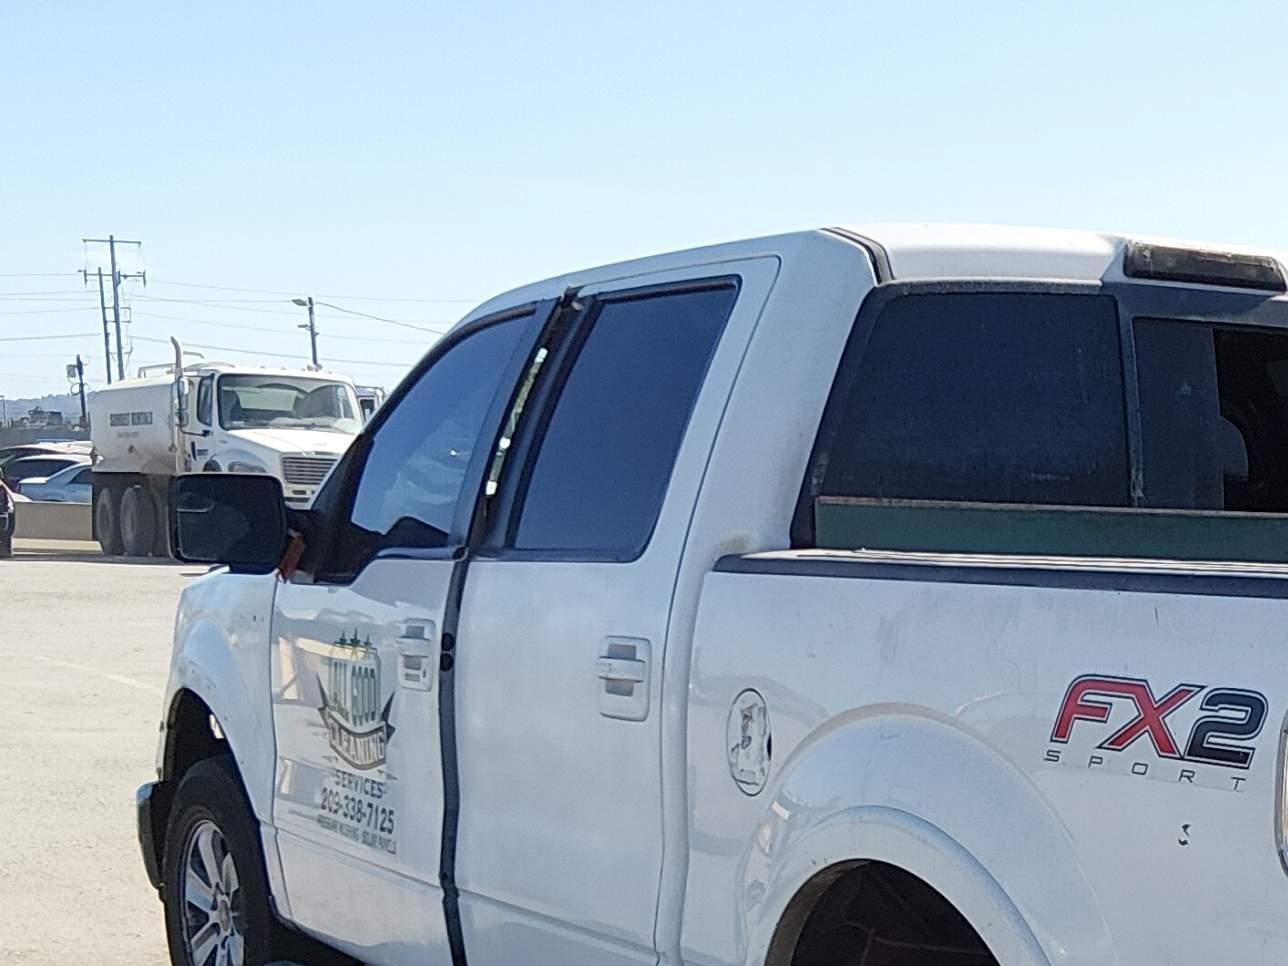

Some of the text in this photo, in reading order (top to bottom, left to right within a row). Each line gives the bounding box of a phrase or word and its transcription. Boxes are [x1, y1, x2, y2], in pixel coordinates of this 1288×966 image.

[1050, 673, 1269, 770] FX2
[335, 768, 384, 799] SERVICES
[1043, 750, 1246, 791] SPORT
[320, 787, 395, 835] 209-338-7125
